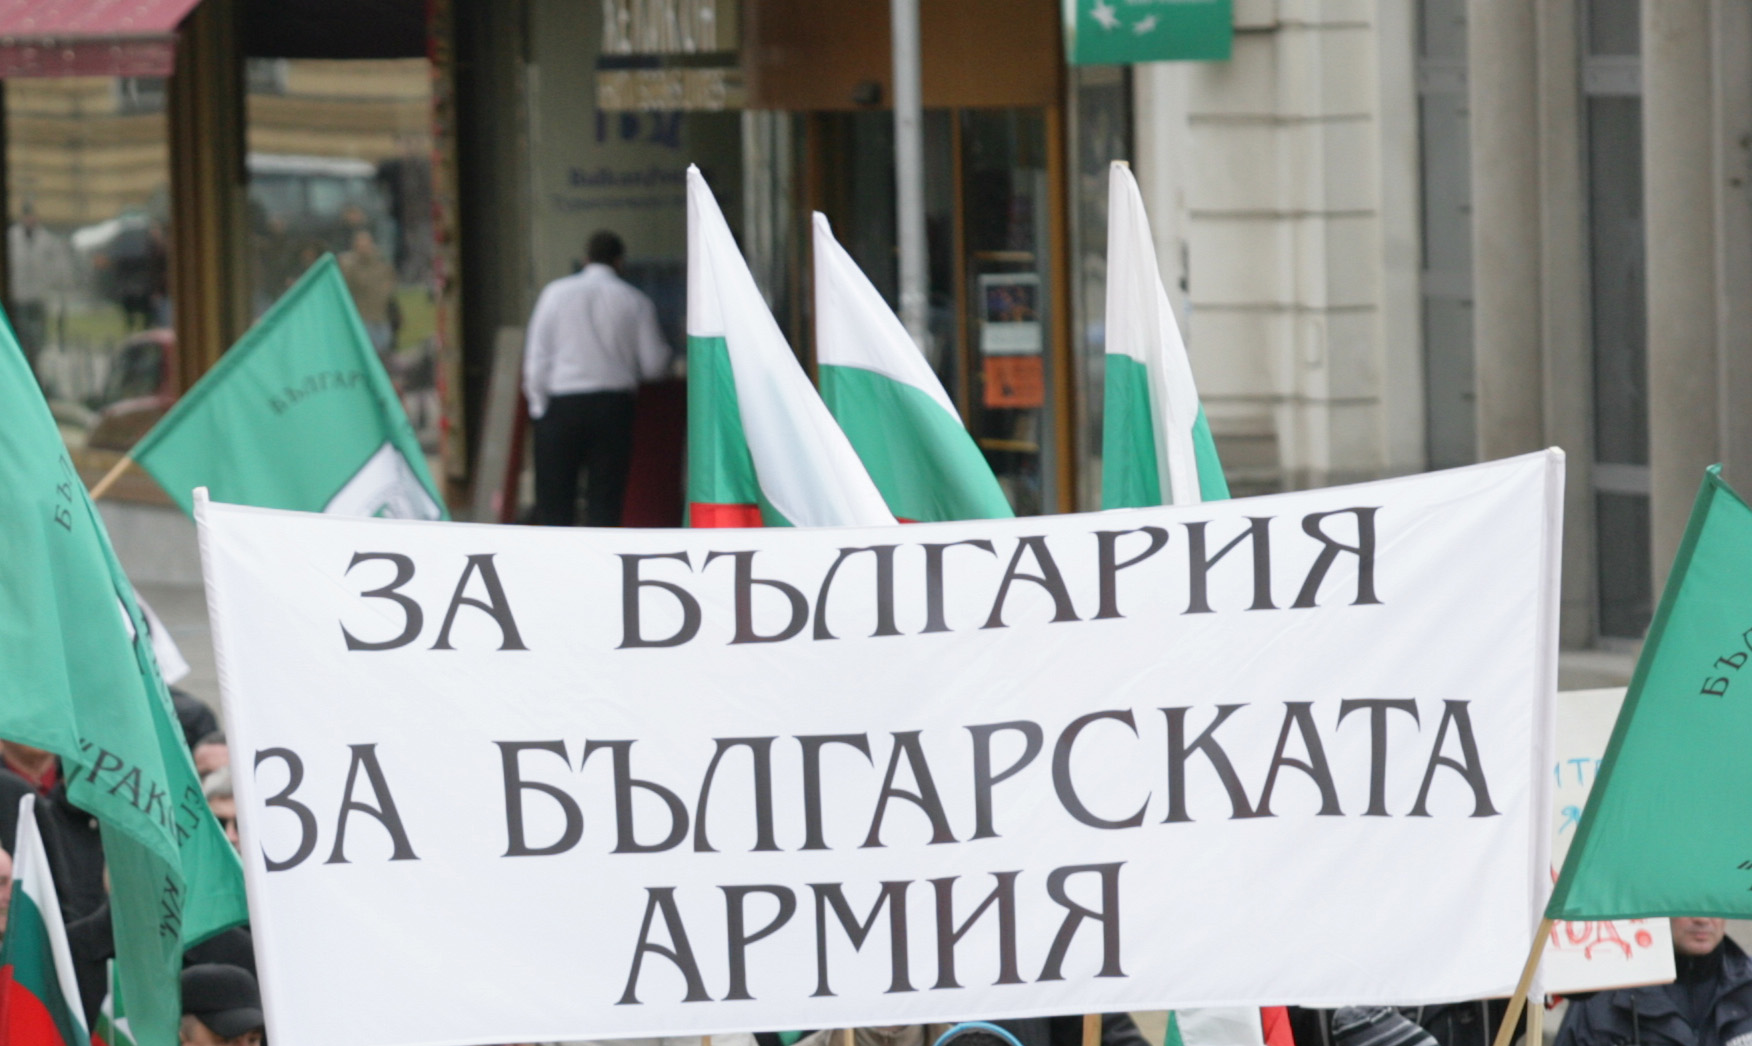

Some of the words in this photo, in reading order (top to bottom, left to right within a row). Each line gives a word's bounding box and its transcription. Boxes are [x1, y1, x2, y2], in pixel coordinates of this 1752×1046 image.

[341, 551, 527, 651] ЗА
[617, 506, 1384, 650] БЪЛГАРИЯ
[253, 743, 419, 873] ЗА
[494, 698, 1500, 857] БЪЛГАРСКАТА
[616, 861, 1127, 1005] АРМИЯ
